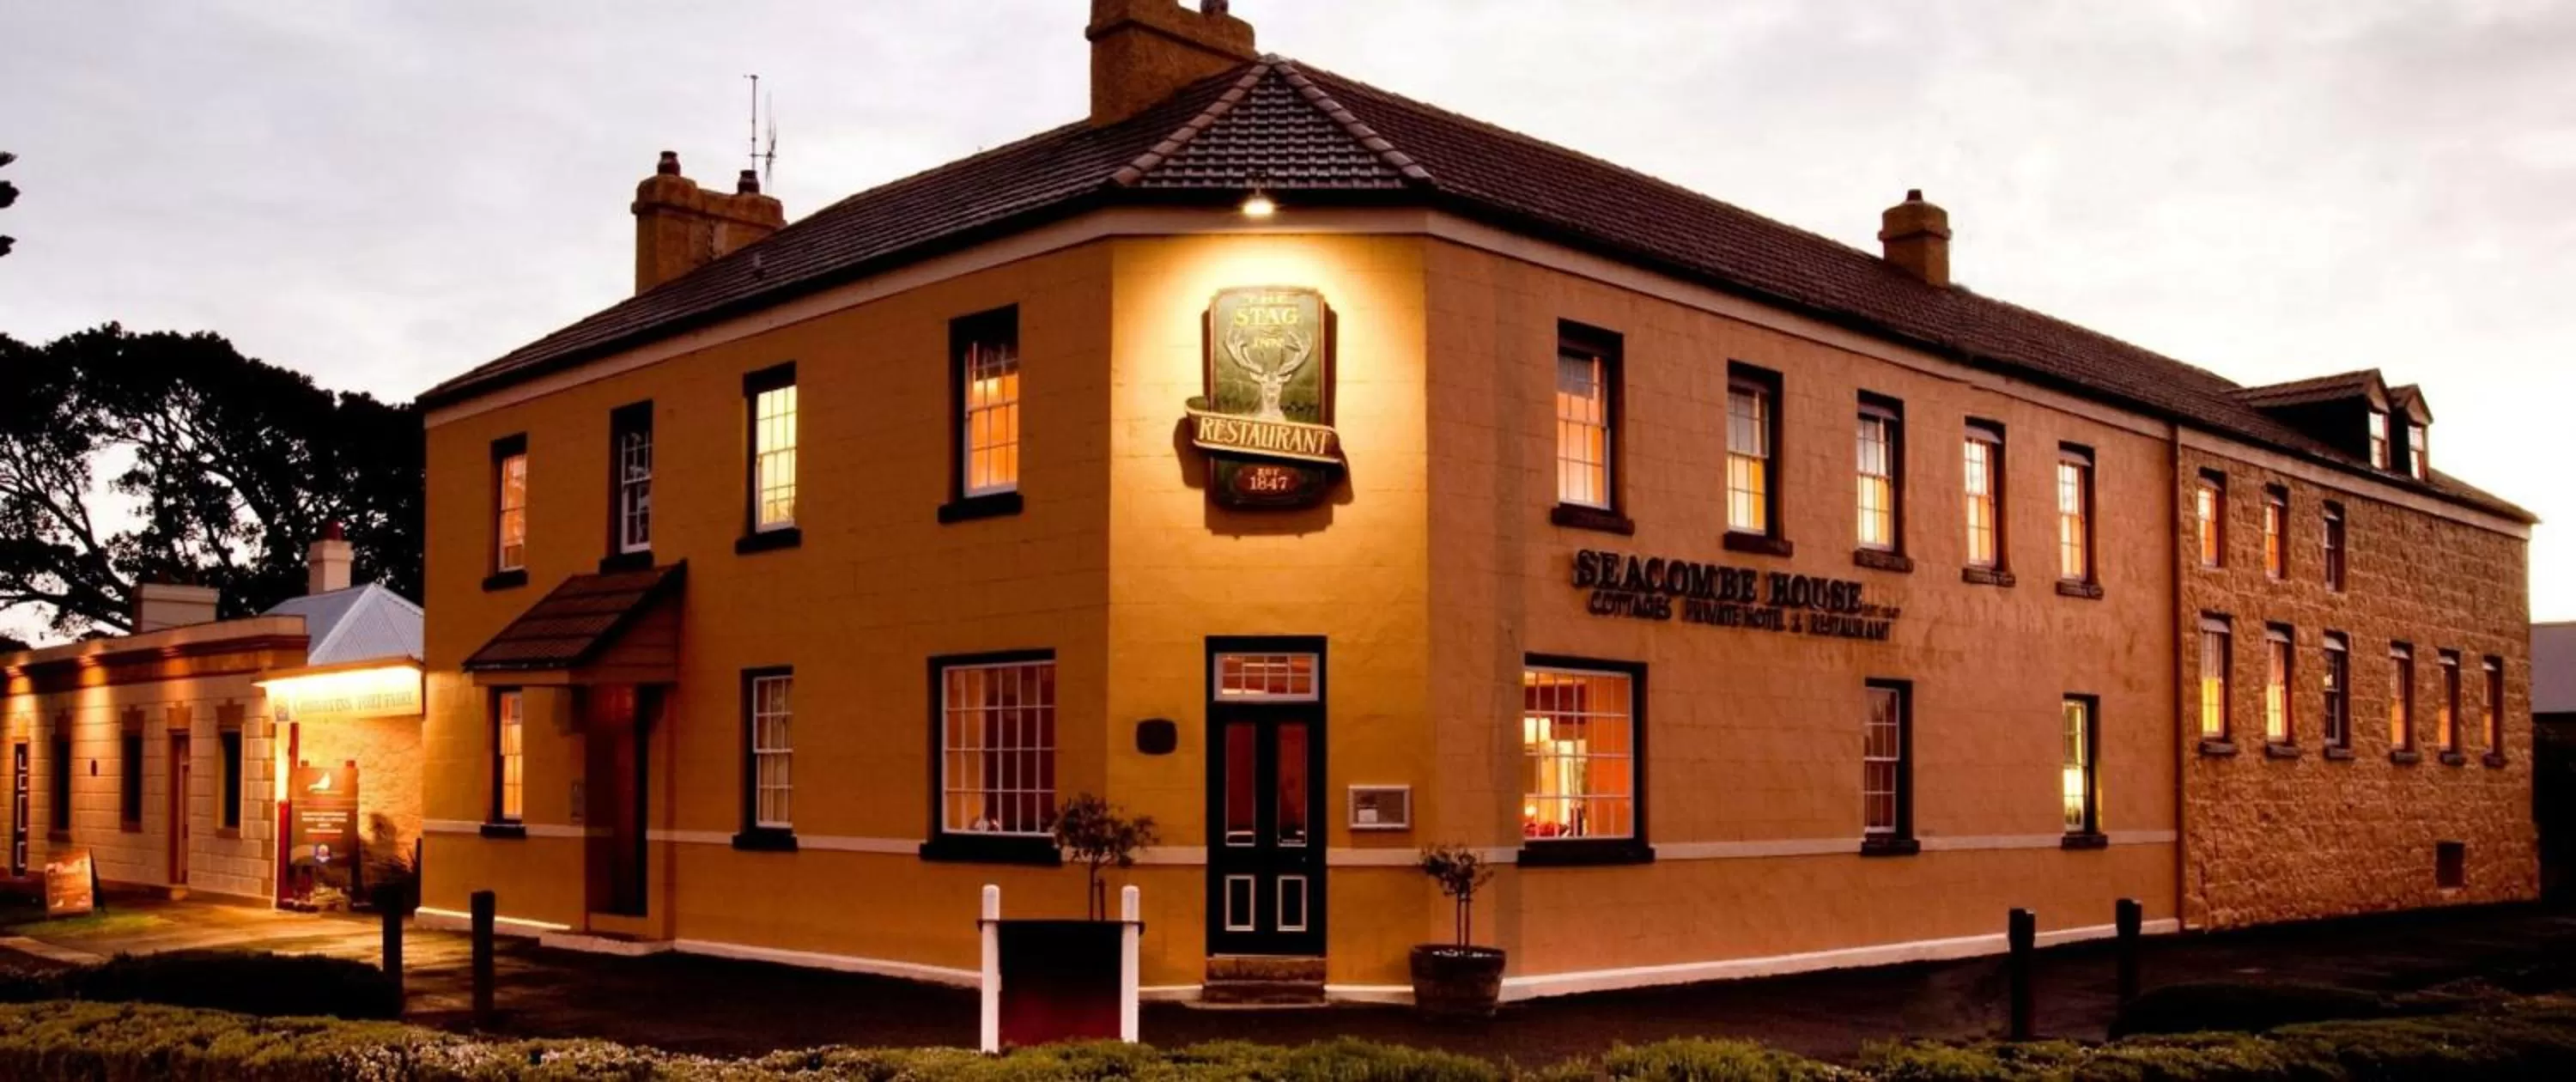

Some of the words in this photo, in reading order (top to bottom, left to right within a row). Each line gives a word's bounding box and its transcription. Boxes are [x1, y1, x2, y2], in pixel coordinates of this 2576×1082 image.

[1234, 307, 1298, 326] STAG
[1199, 416, 1331, 454] RESTAURANT
[1249, 476, 1289, 490] 1847
[1572, 549, 1759, 601] SEACOMBE
[1769, 571, 1862, 613] HOUSE
